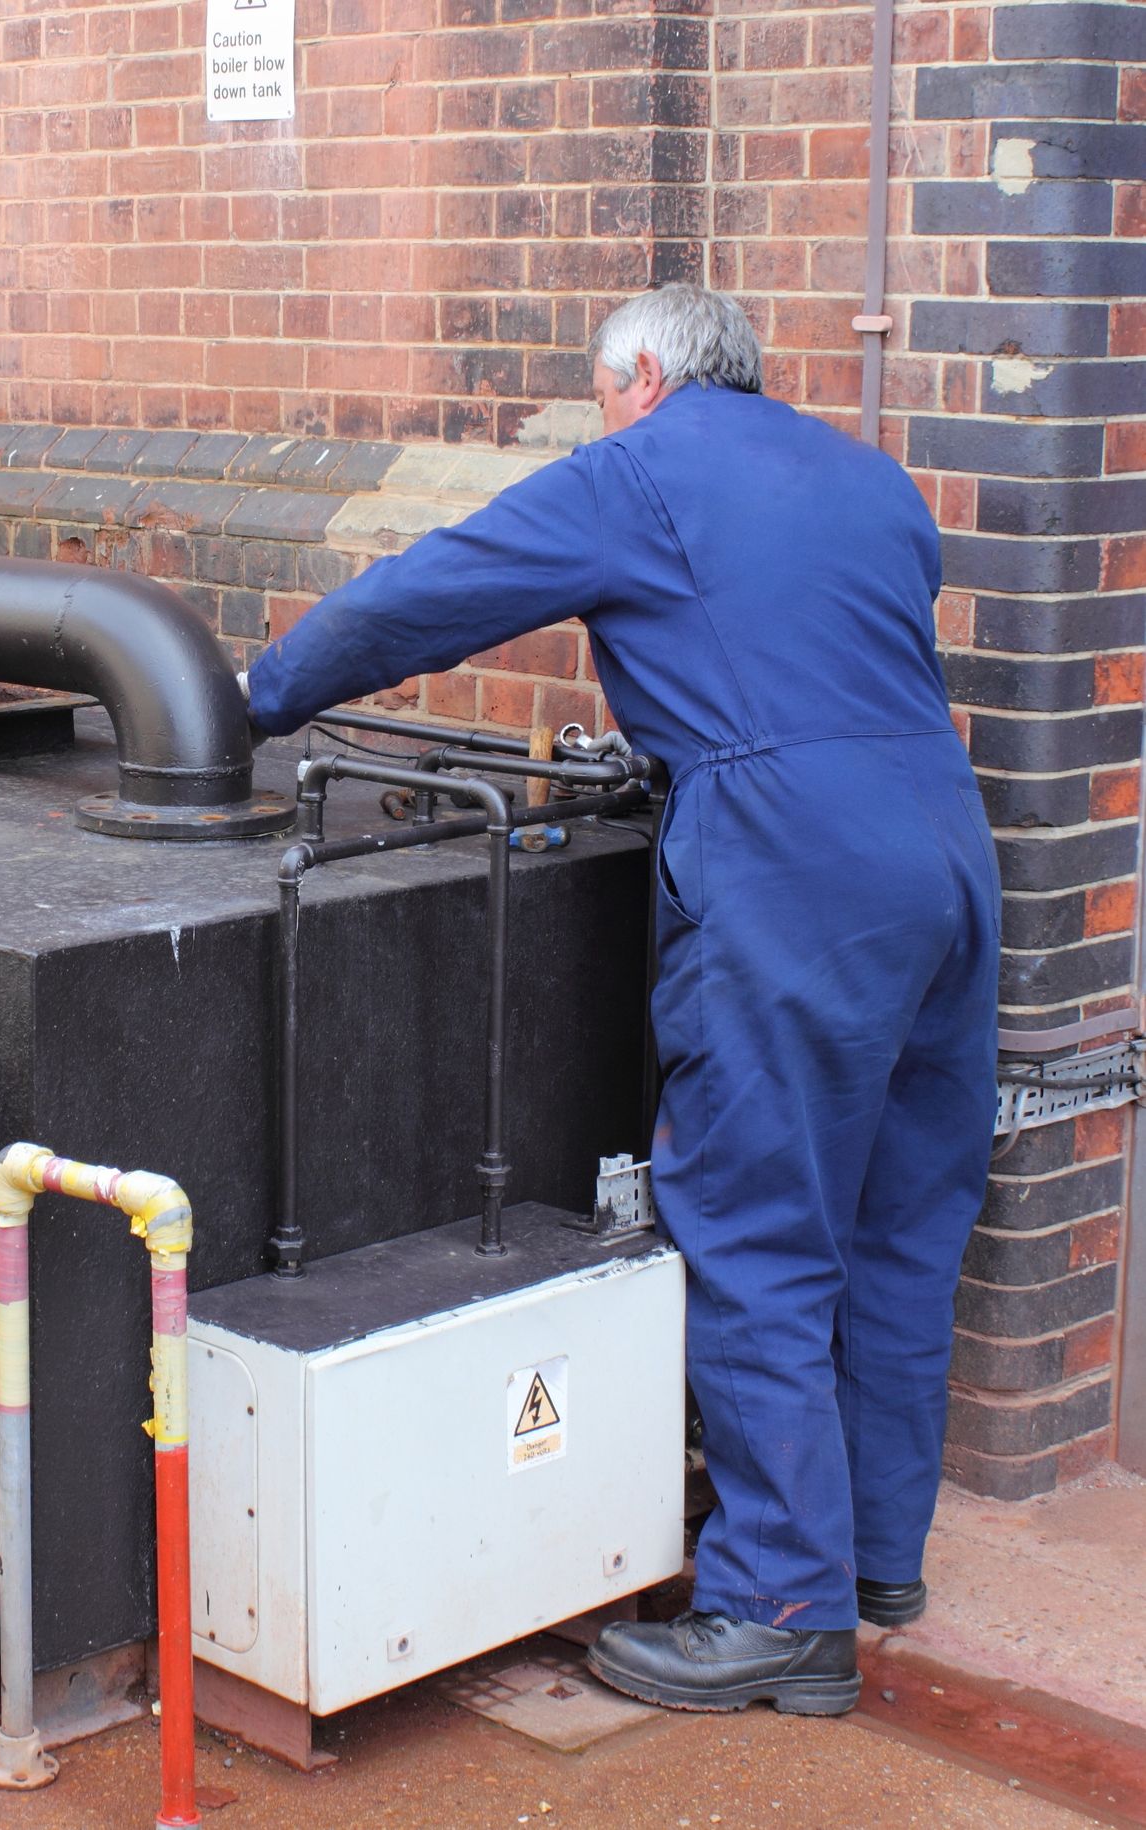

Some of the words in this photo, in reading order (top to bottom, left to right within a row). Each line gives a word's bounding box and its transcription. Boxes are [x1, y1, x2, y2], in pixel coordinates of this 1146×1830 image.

[213, 31, 262, 48] Caution
[213, 57, 248, 74] boiler
[254, 56, 285, 72] blow
[214, 84, 246, 100] down
[253, 81, 282, 98] tank
